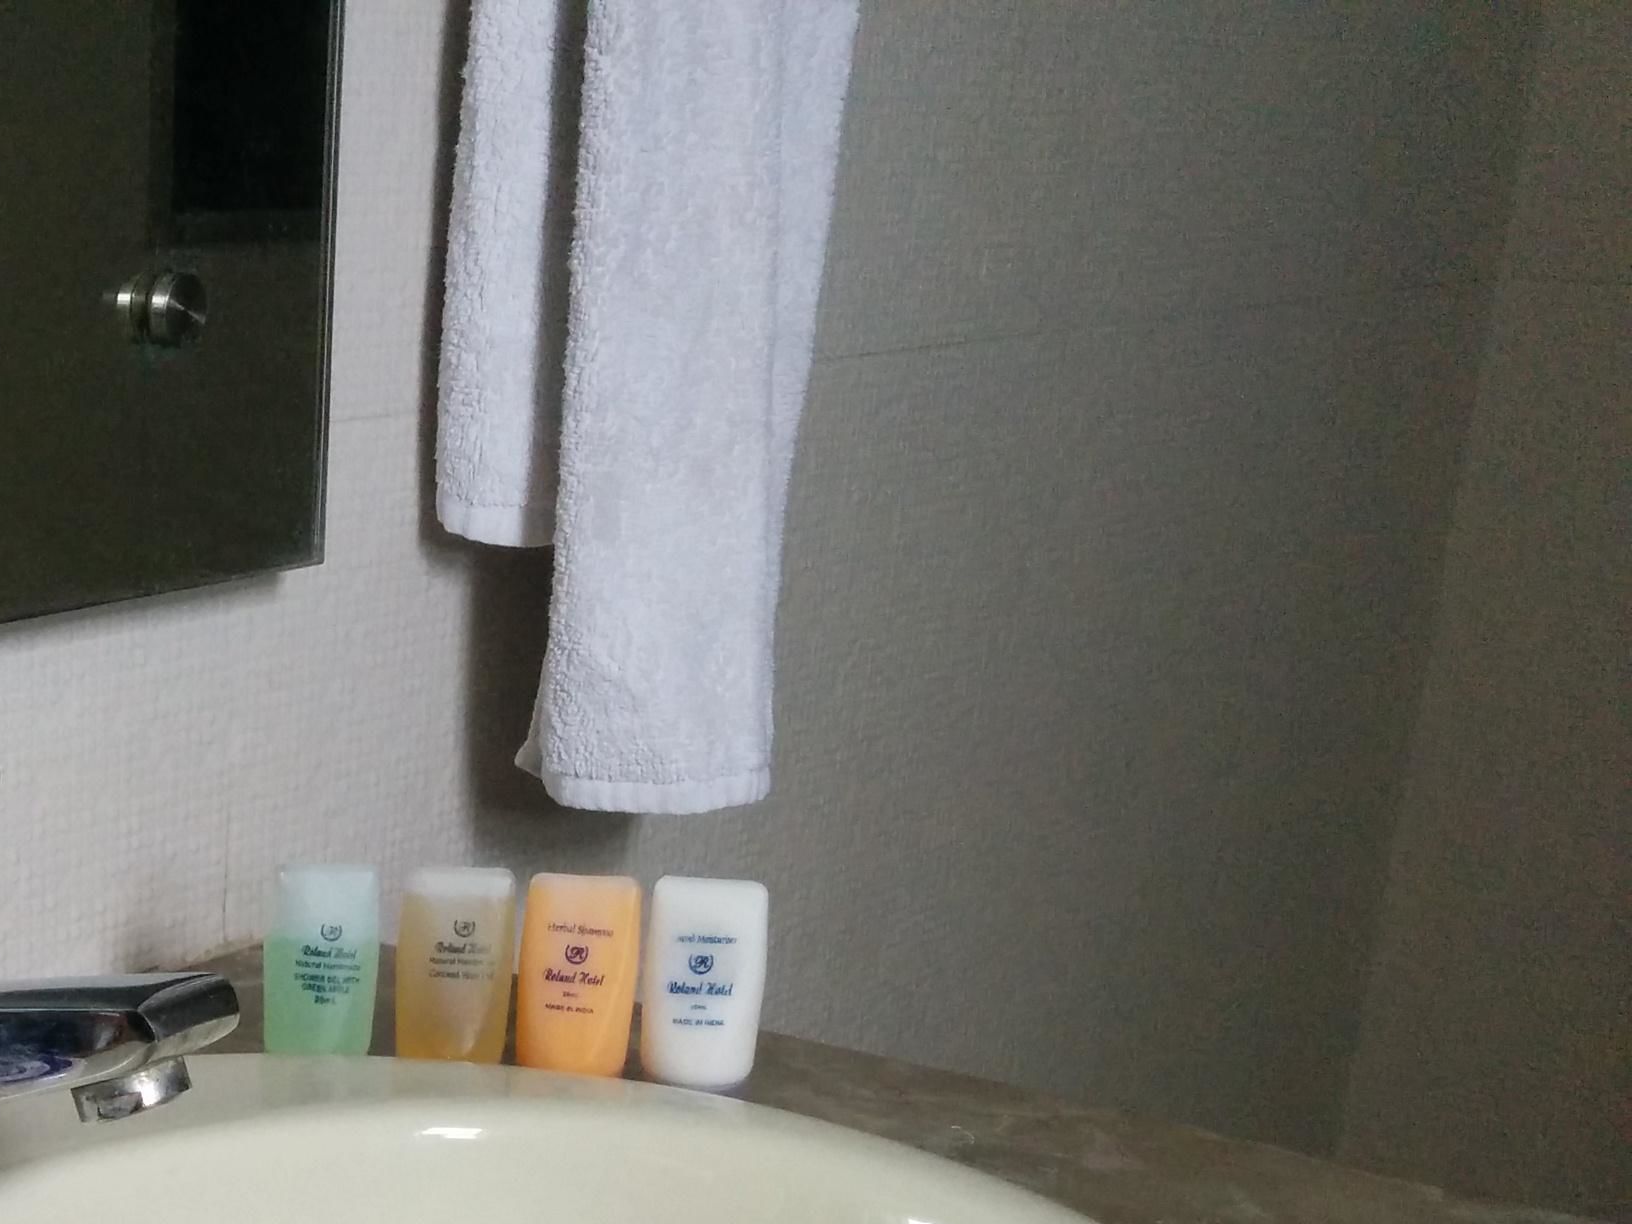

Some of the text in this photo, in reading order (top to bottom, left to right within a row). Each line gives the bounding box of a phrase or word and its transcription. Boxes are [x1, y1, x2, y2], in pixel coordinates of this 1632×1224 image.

[543, 967, 606, 987] Roland Hotel
[667, 980, 734, 997] Roland Hotel
